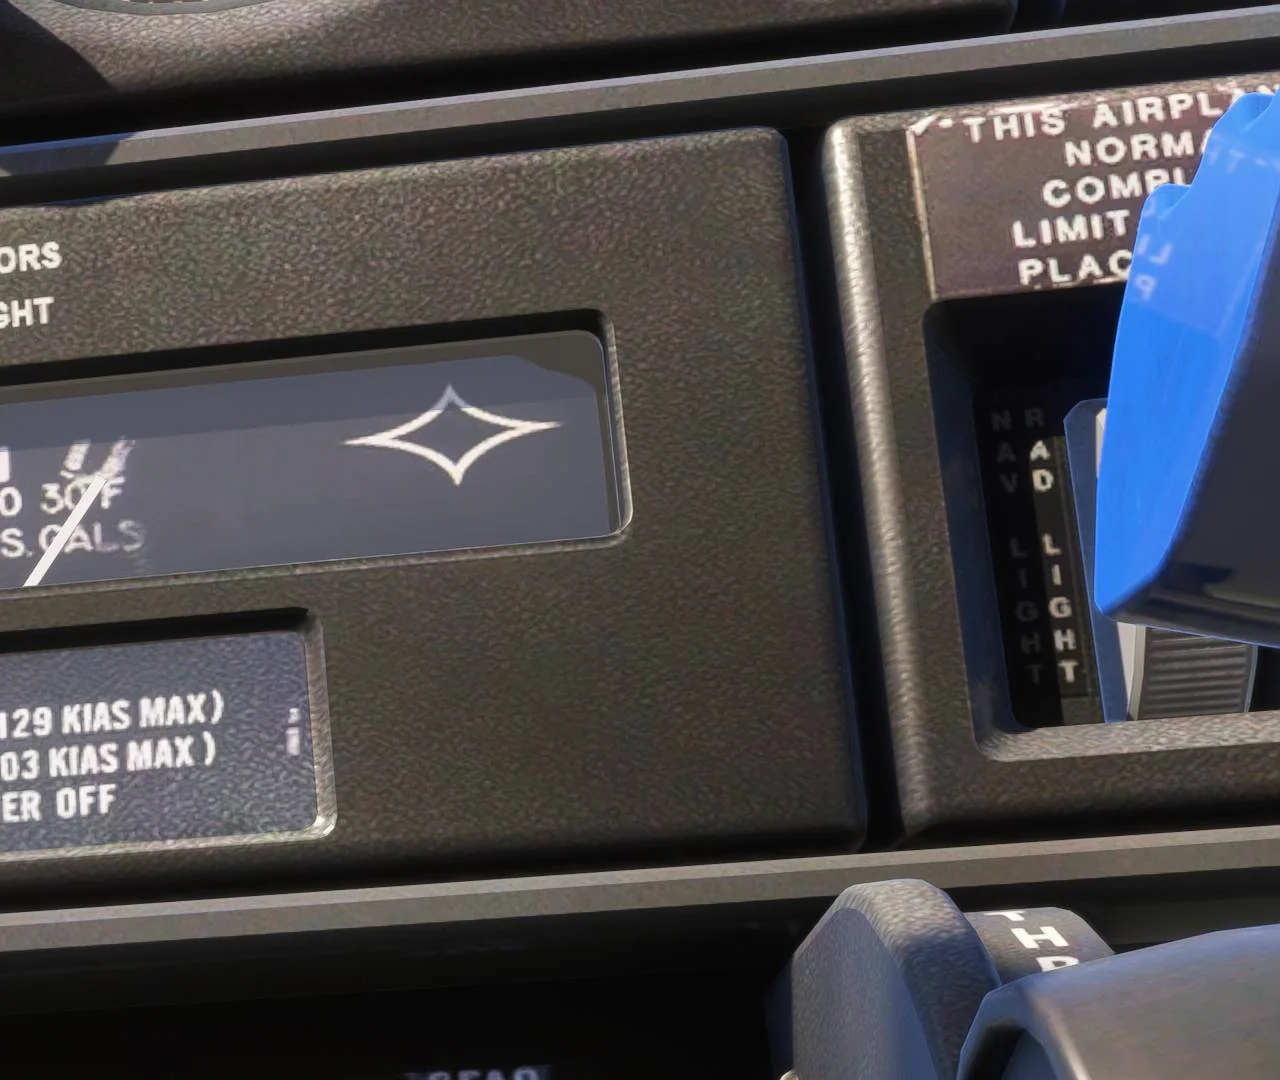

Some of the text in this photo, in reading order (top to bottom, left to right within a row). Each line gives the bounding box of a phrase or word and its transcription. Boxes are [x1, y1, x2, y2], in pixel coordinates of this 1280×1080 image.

[963, 108, 1066, 143] THIS
[1041, 532, 1080, 684] LIGHT
[61, 699, 130, 735] KIAS
[139, 689, 225, 729] MAX)
[48, 741, 119, 777] KIAS
[55, 783, 119, 818] OFF
